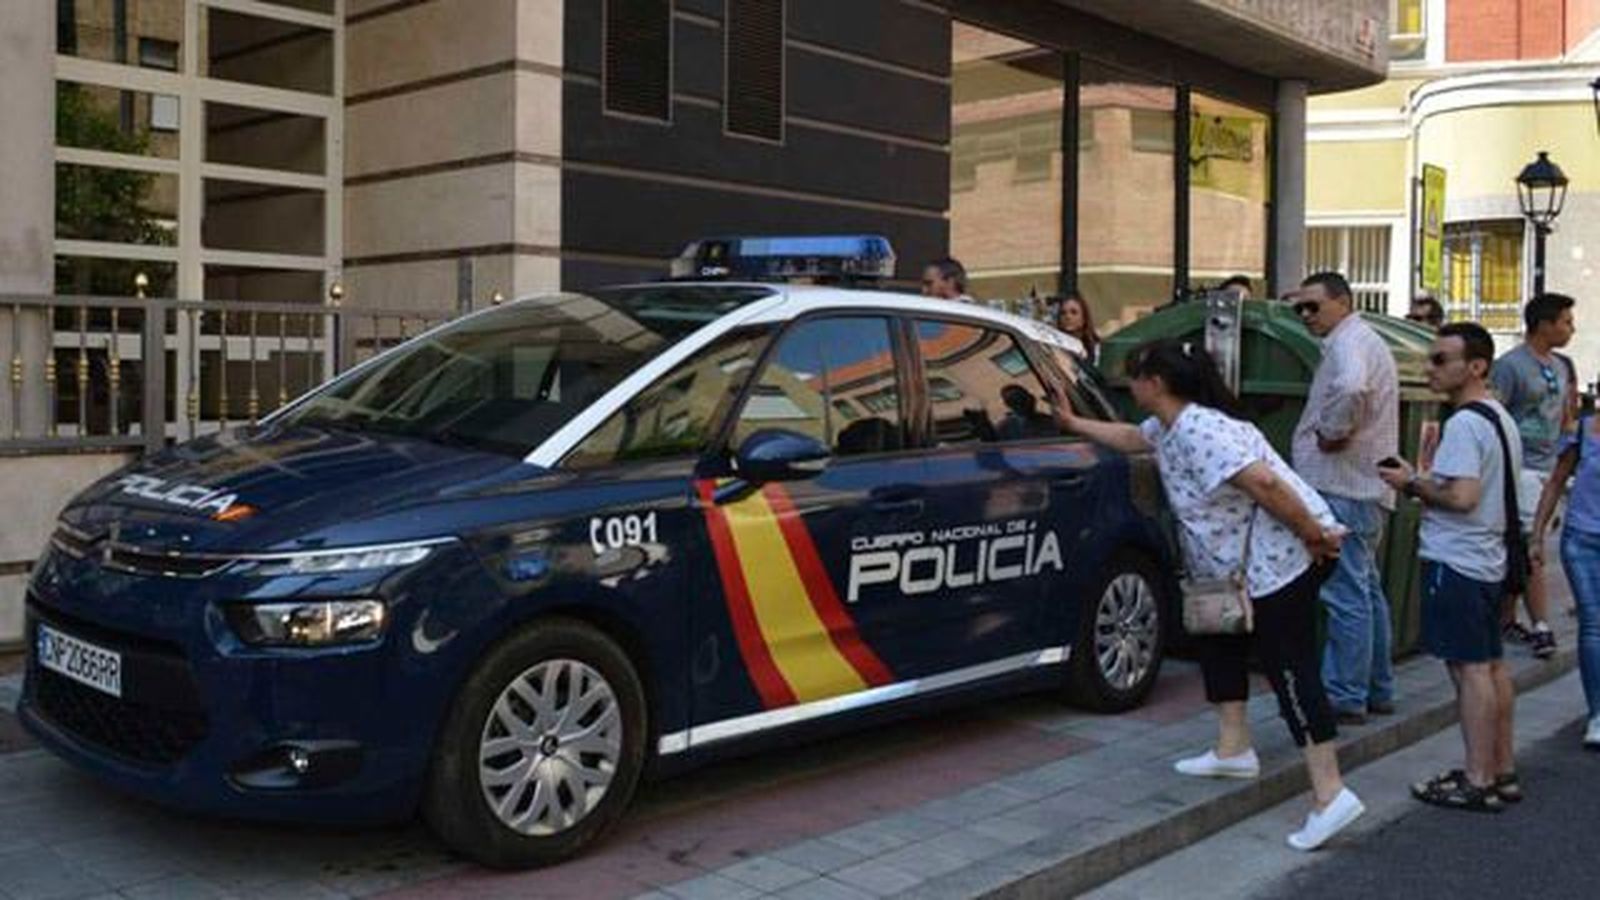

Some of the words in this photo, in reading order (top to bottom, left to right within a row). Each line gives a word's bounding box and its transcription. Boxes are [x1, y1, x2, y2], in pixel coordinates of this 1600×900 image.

[847, 520, 1064, 602] POLICÍA
[851, 532, 924, 550] CUERPO
[932, 523, 1002, 543] NACIONAL
[1006, 519, 1027, 533] DE
